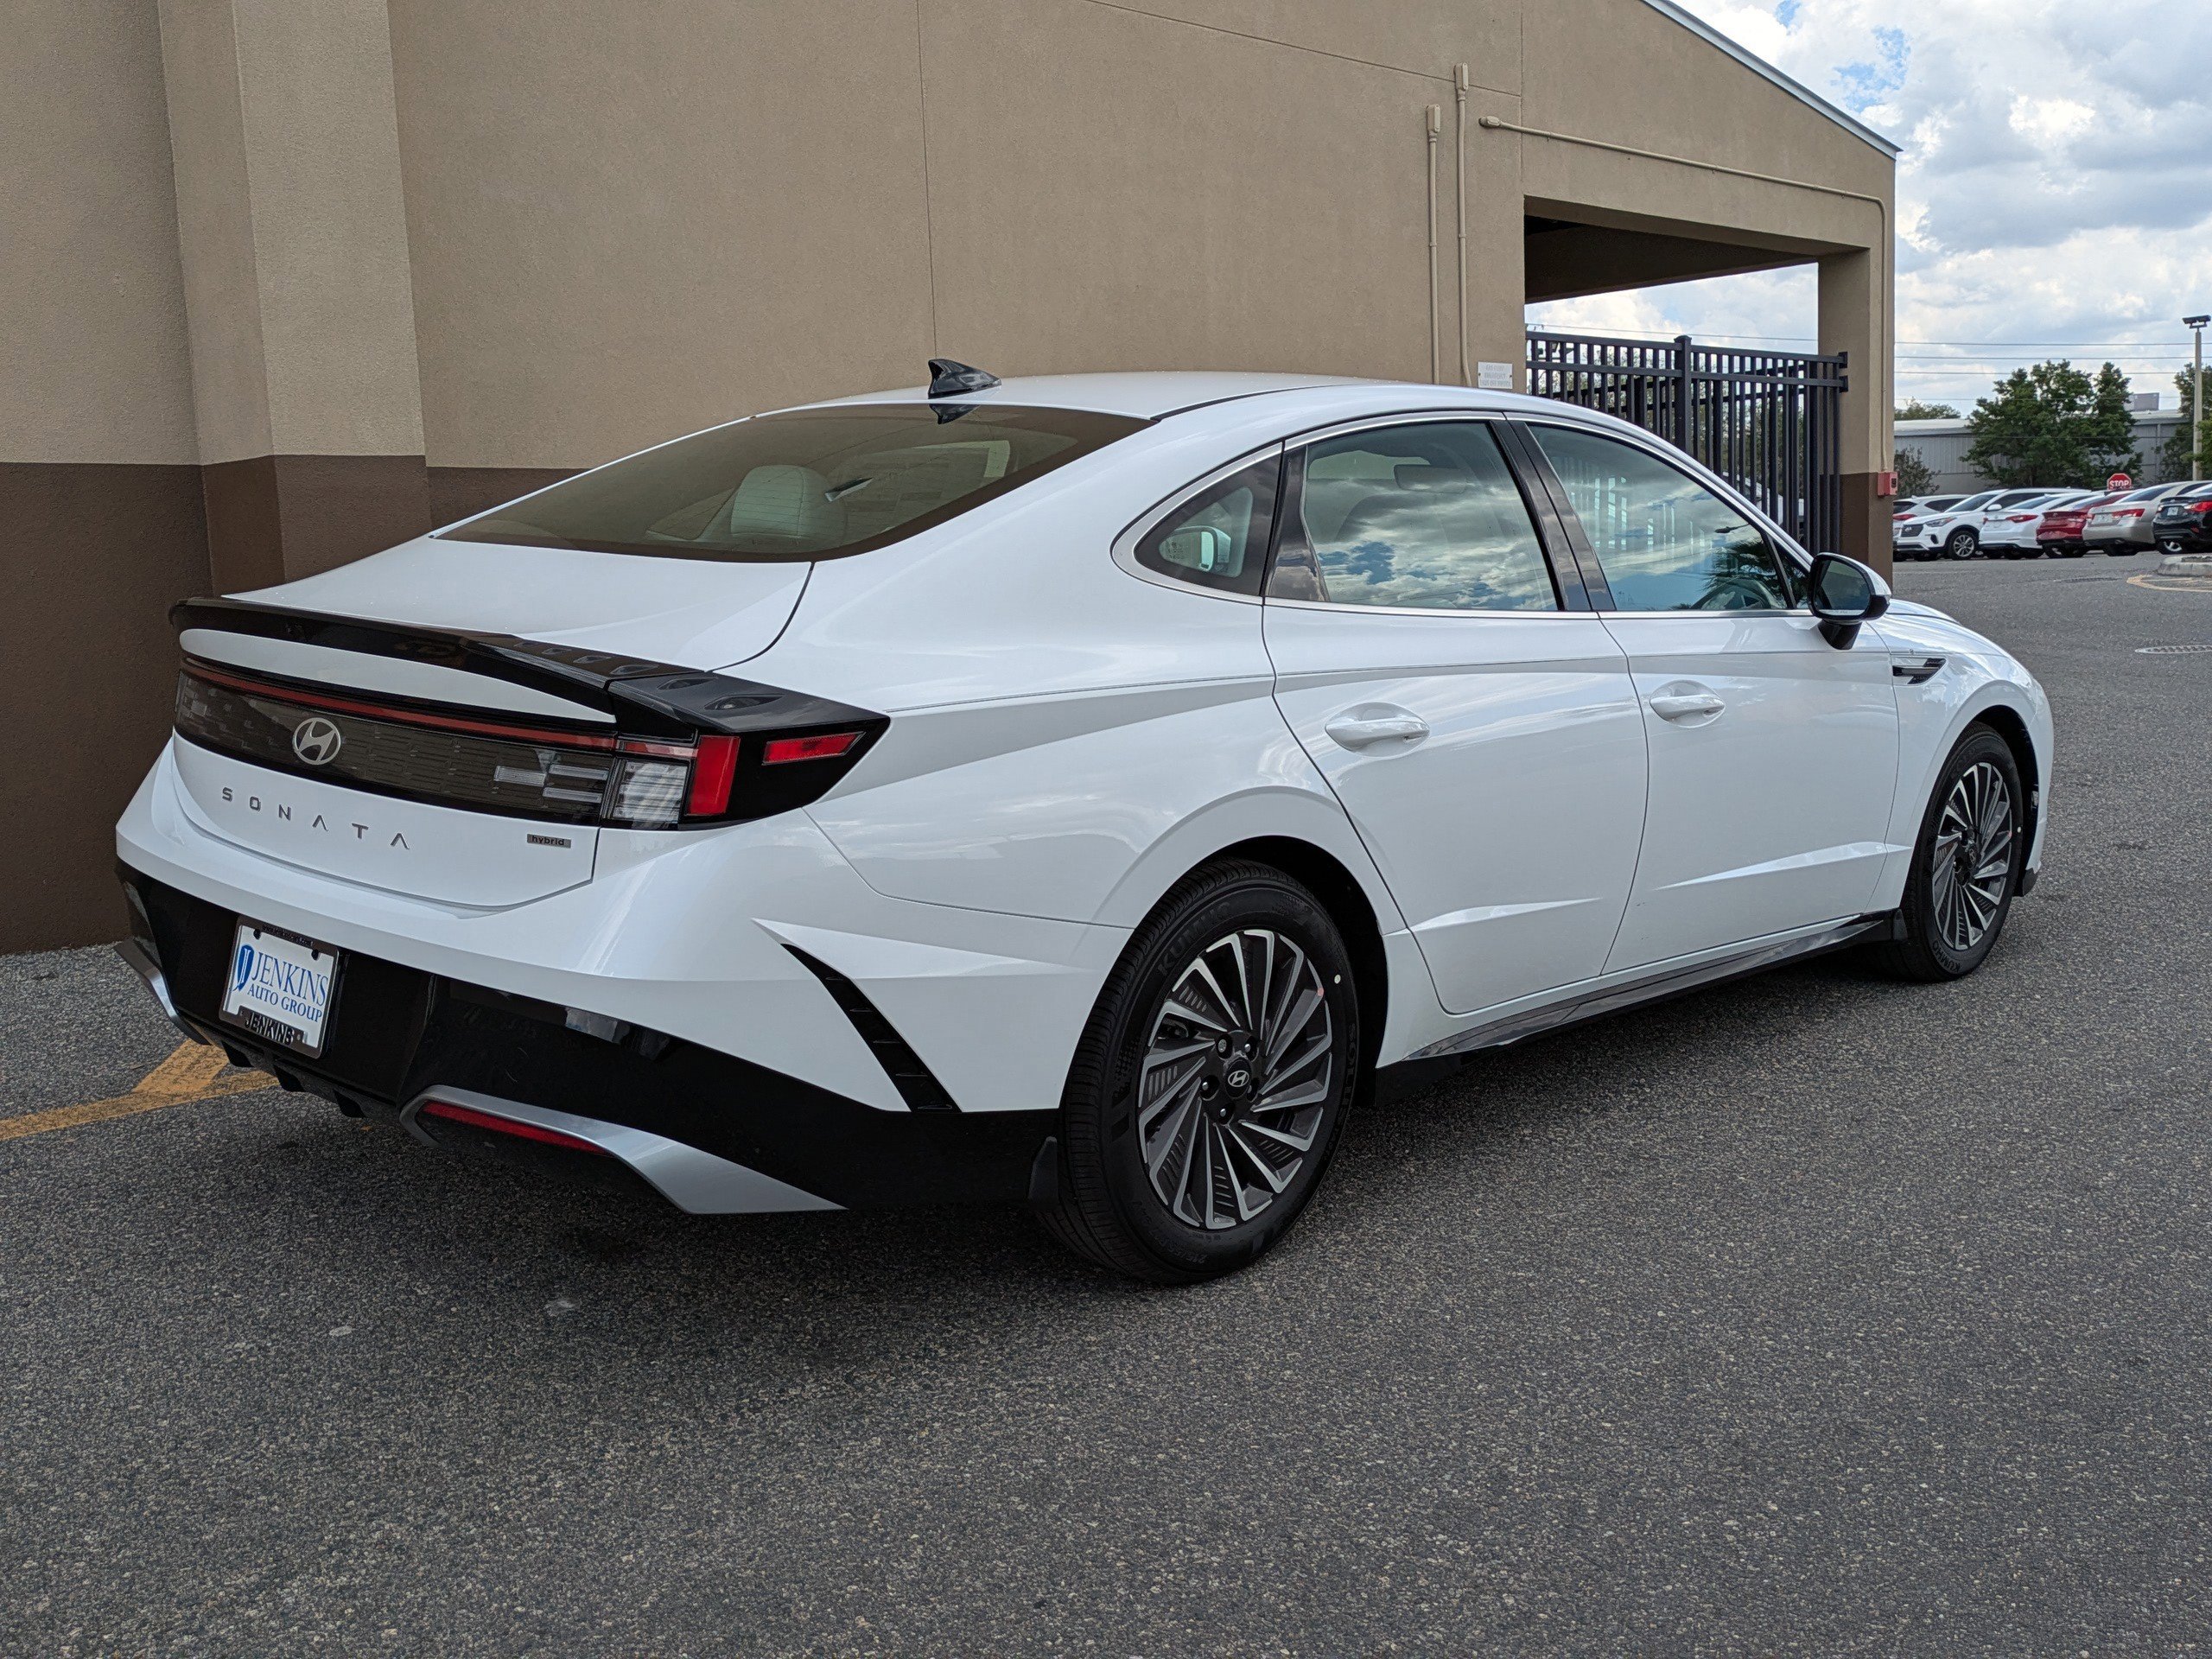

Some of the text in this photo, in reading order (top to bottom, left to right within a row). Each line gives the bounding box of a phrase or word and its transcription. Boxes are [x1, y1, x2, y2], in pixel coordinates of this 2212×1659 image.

[2109, 480, 2129, 488] STOP
[221, 786, 410, 850] SONATA
[531, 835, 564, 845] hybrid
[251, 951, 329, 1007] JENKINS
[247, 983, 322, 1023] AUTO GROUP
[245, 1012, 295, 1046] JENKINS
